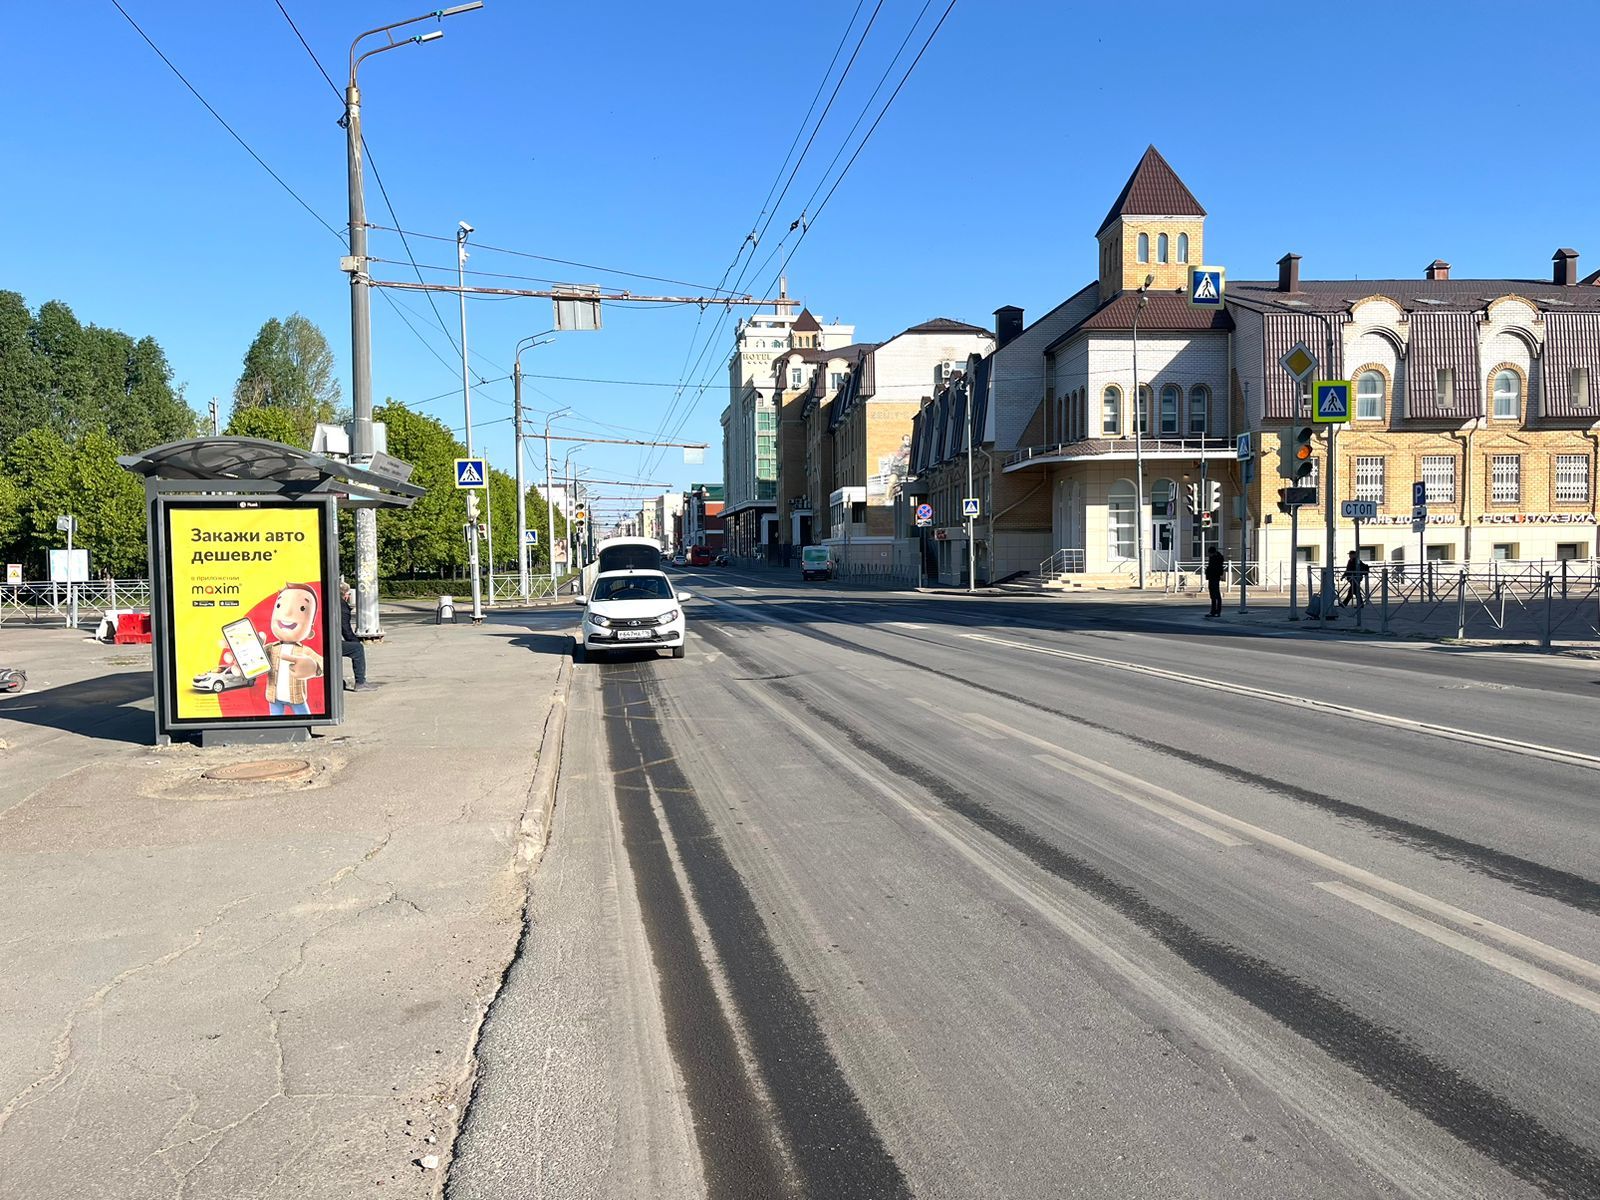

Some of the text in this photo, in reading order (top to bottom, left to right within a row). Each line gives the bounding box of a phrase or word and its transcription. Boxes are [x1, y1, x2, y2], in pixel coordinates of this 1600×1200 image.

[743, 353, 771, 361] HOTEL
[1345, 503, 1372, 515] СТОП
[191, 528, 305, 542] Закажи авто
[191, 582, 240, 595] maxim
